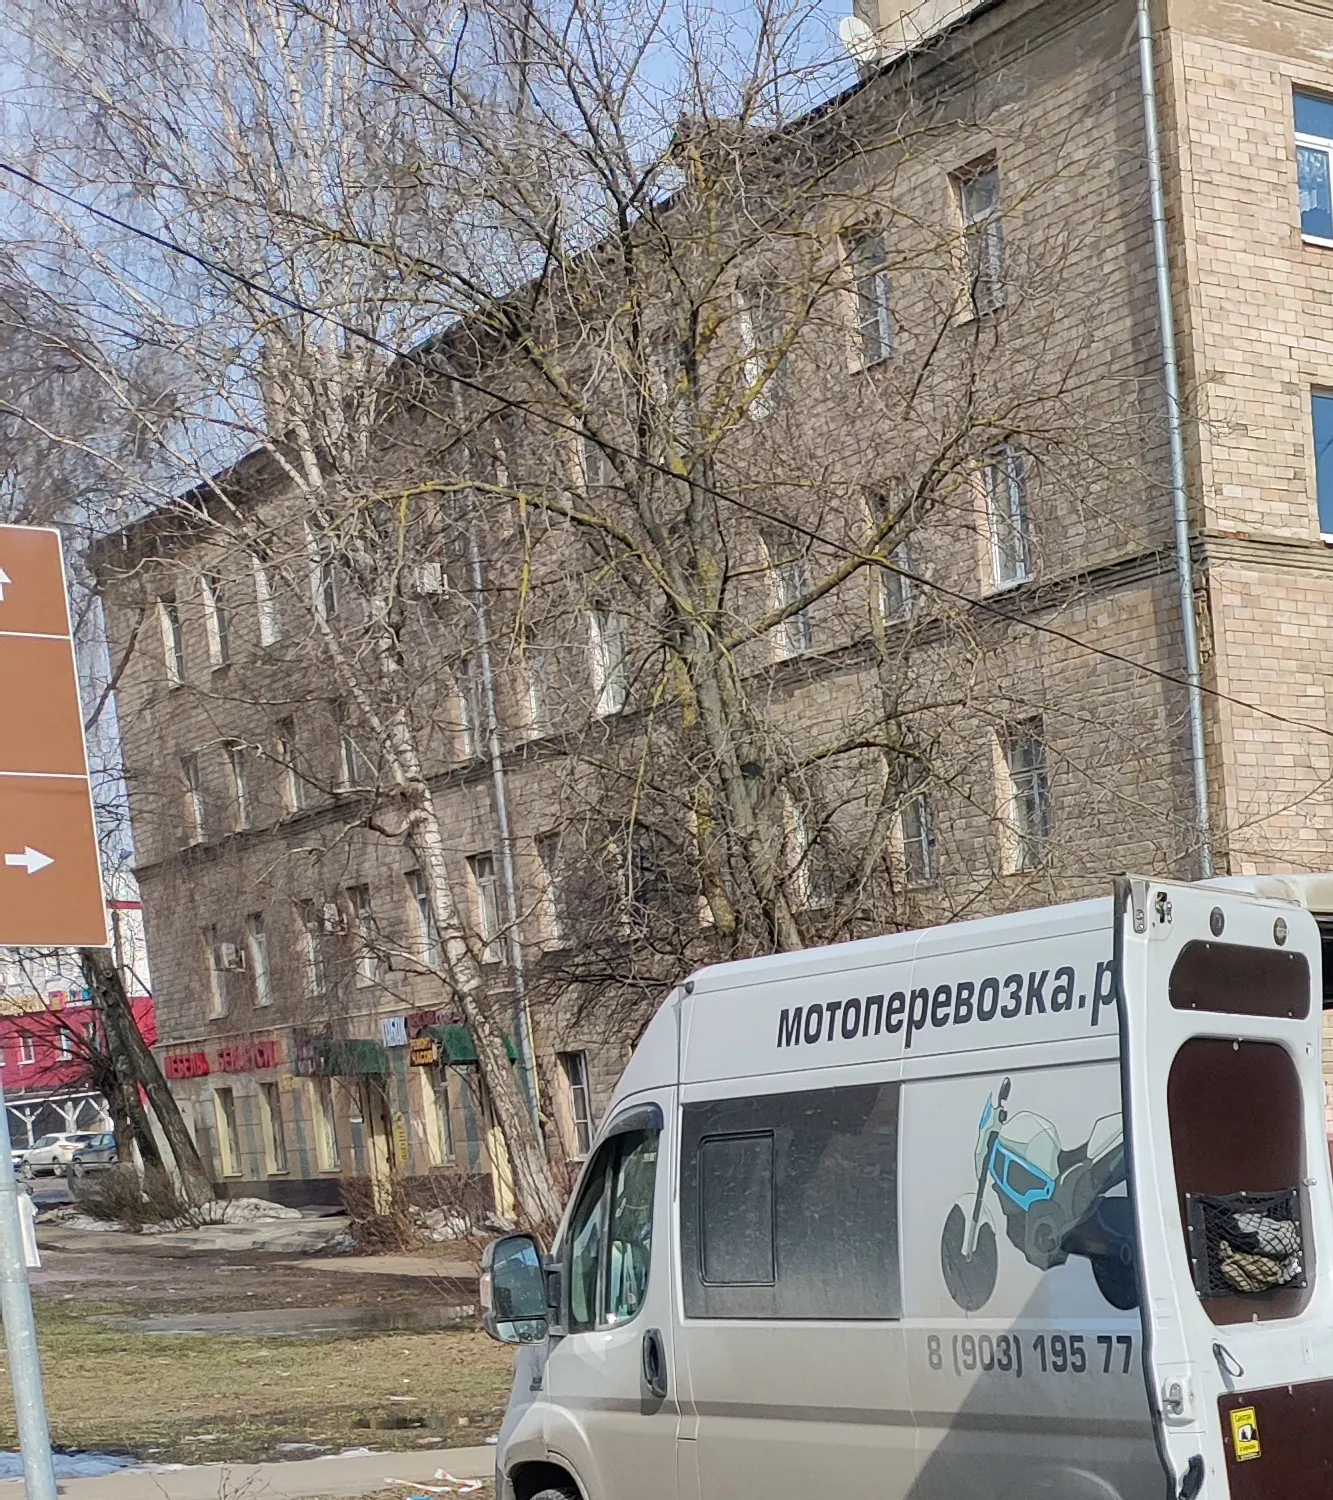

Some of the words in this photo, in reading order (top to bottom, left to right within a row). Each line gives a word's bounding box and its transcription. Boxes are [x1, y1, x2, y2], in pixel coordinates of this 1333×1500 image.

[927, 1334, 942, 1370] 8
[952, 1334, 1022, 1378] (903)
[1033, 1335, 1086, 1373] 195
[1097, 1335, 1132, 1373] 77
